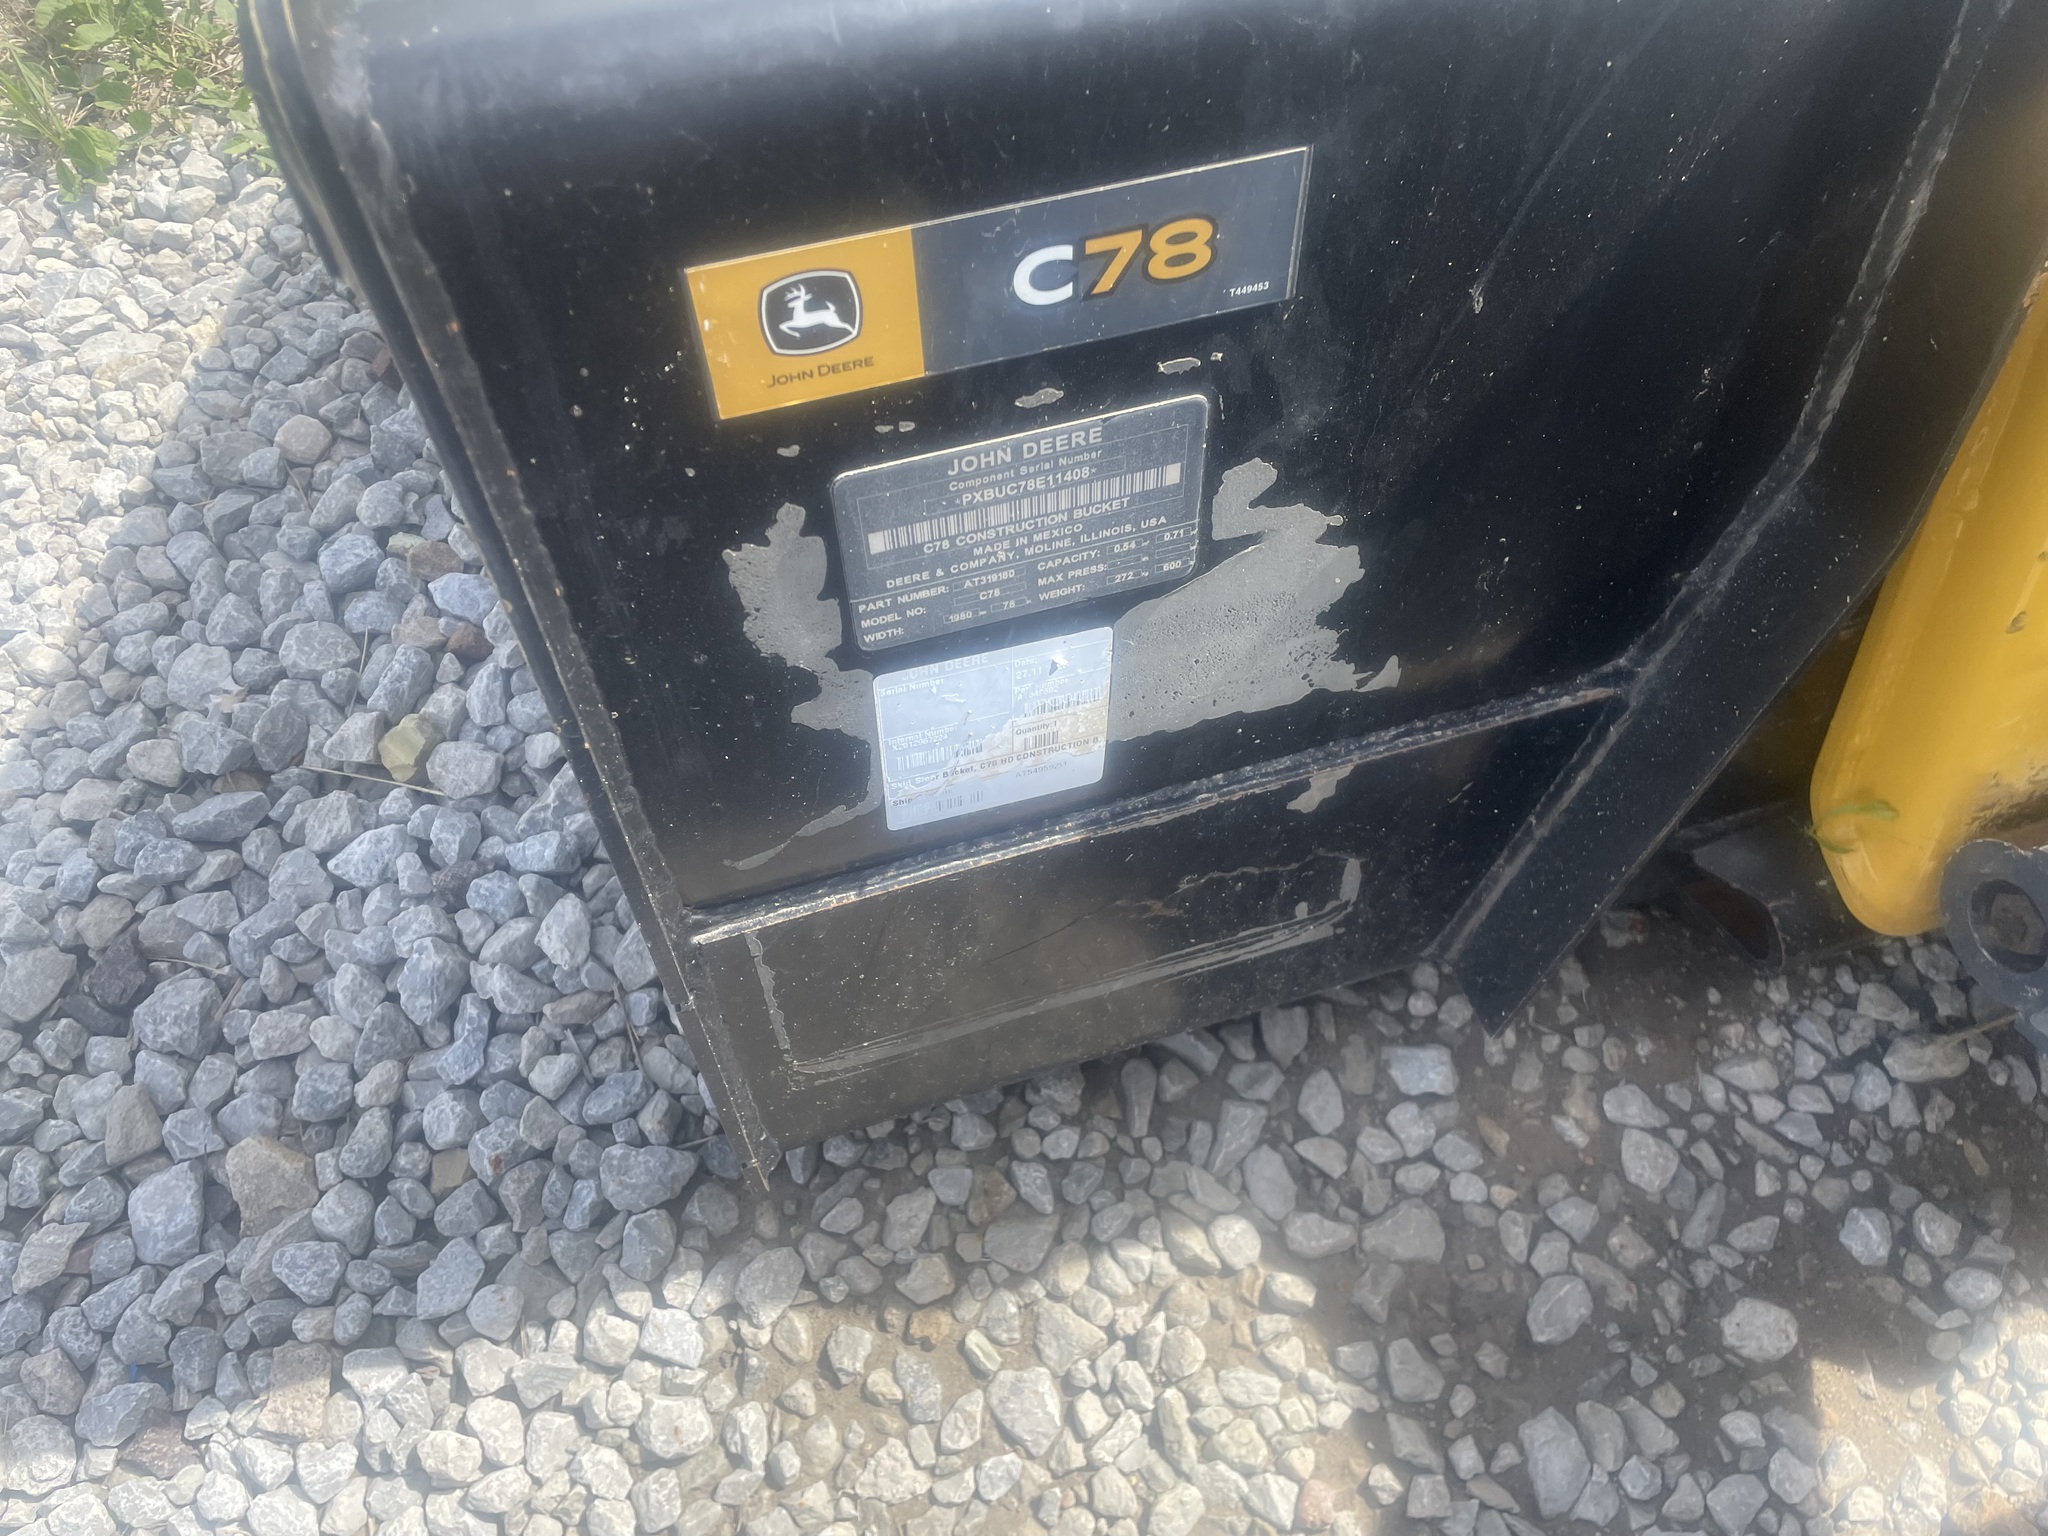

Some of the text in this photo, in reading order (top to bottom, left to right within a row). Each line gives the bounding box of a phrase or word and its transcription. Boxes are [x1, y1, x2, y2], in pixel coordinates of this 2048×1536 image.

[1013, 217, 1217, 306] C78
[767, 356, 875, 388] JOHN DEERE
[947, 427, 1103, 476] JOHN DEERE
[949, 450, 1103, 491] Component Serial Number
[923, 497, 1131, 555] C78 CONSTRUCTION BUCKET
[973, 523, 1083, 556] MADE IN MEXICO
[886, 515, 1167, 589] DEERE & COMPANY, MOLINE, ILLINOIS, USA
[1037, 549, 1100, 571] CAPACITY:
[1114, 541, 1136, 553] 0.54
[1164, 529, 1184, 541] 0.71
[1037, 563, 1107, 587] MAX PRESS:
[1038, 584, 1085, 601] WEIGHT:
[1115, 571, 1134, 583] 272
[858, 599, 892, 613] PART
[898, 586, 949, 605] NUMBER:
[861, 588, 1000, 628] MODEL NO: C78
[863, 627, 904, 643] WIDTH:
[949, 611, 973, 622] 1980
[1003, 600, 1015, 611] 78
[902, 653, 989, 681] JOHN DEERE
[880, 678, 944, 697] Serial Number
[1014, 686, 1031, 696] Par
[888, 726, 958, 746] Internal Number
[1000, 756, 1014, 764] HD
[1016, 738, 1089, 761] CONSTRUCTION
